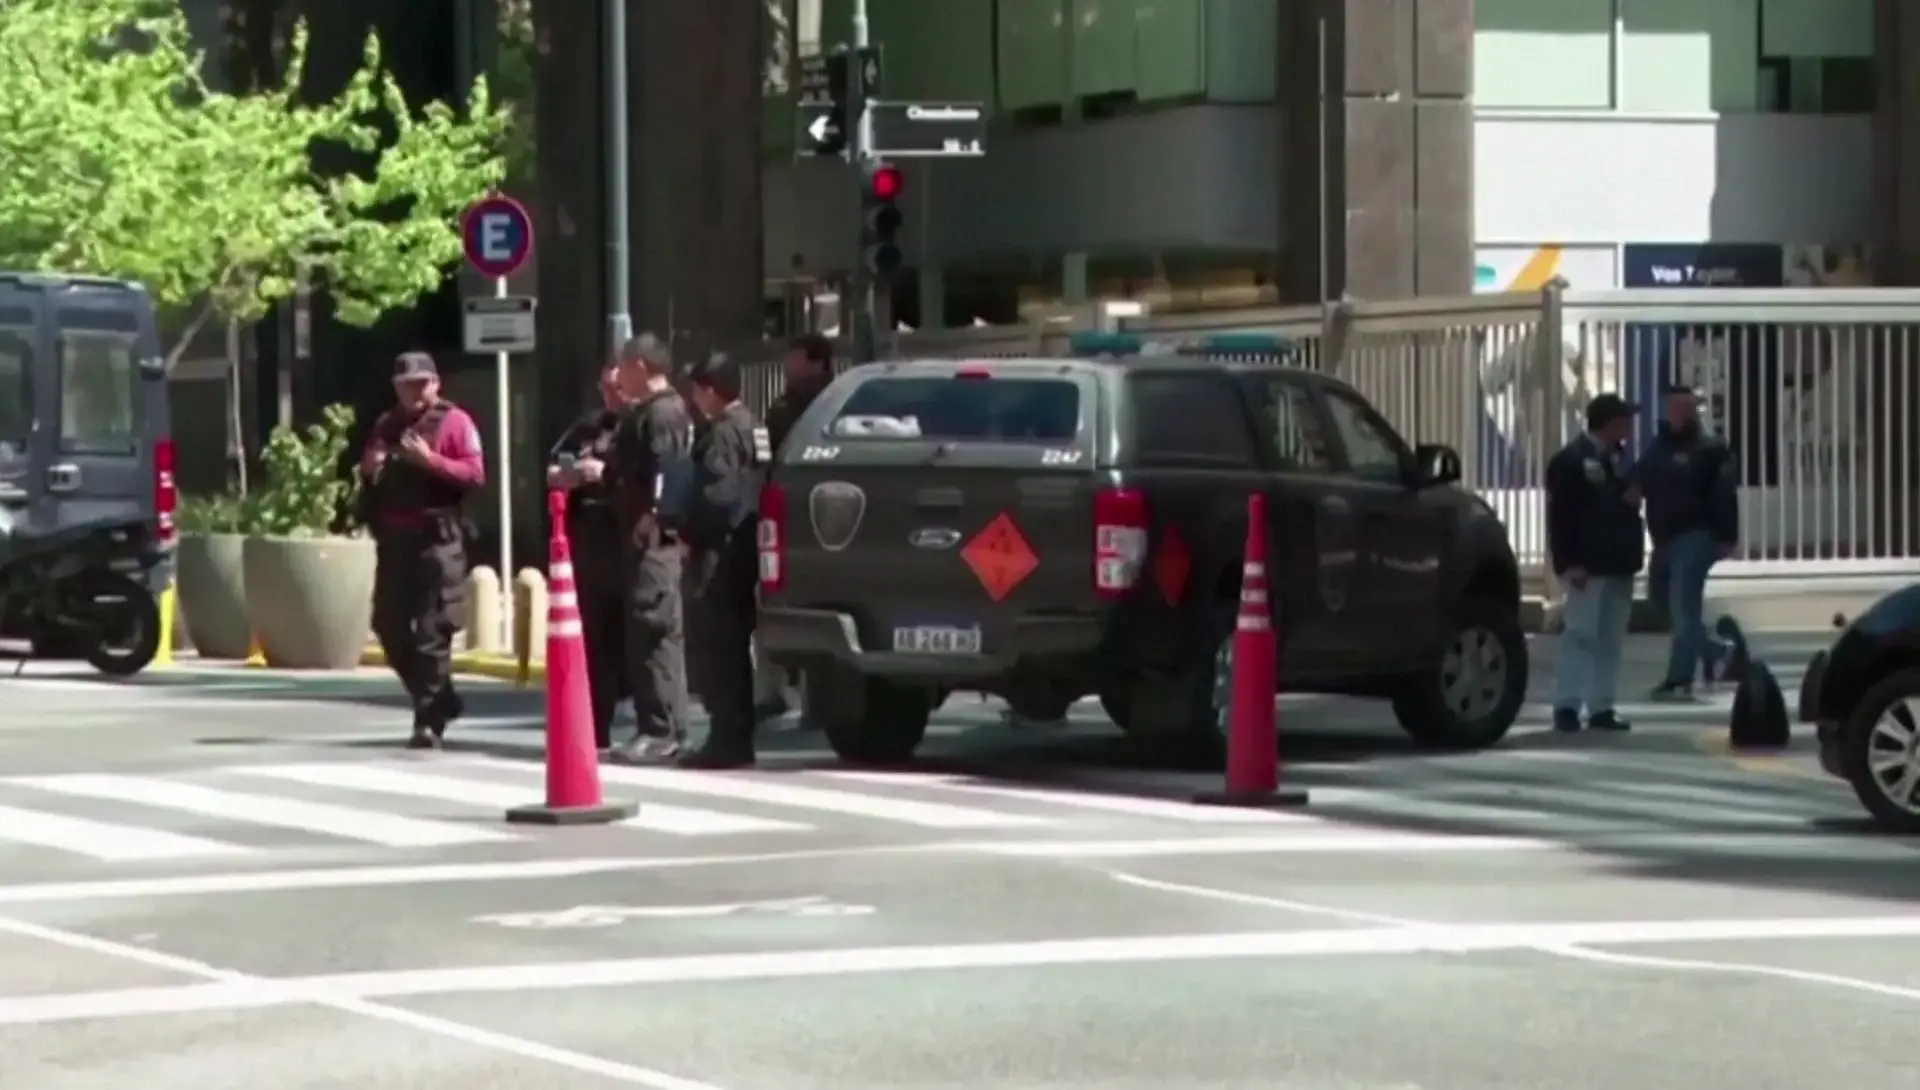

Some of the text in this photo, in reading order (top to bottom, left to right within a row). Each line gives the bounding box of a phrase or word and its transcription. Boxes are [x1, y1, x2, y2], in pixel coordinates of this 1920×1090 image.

[481, 213, 511, 262] E
[802, 445, 840, 460] 2247
[1042, 448, 1082, 466] 2247
